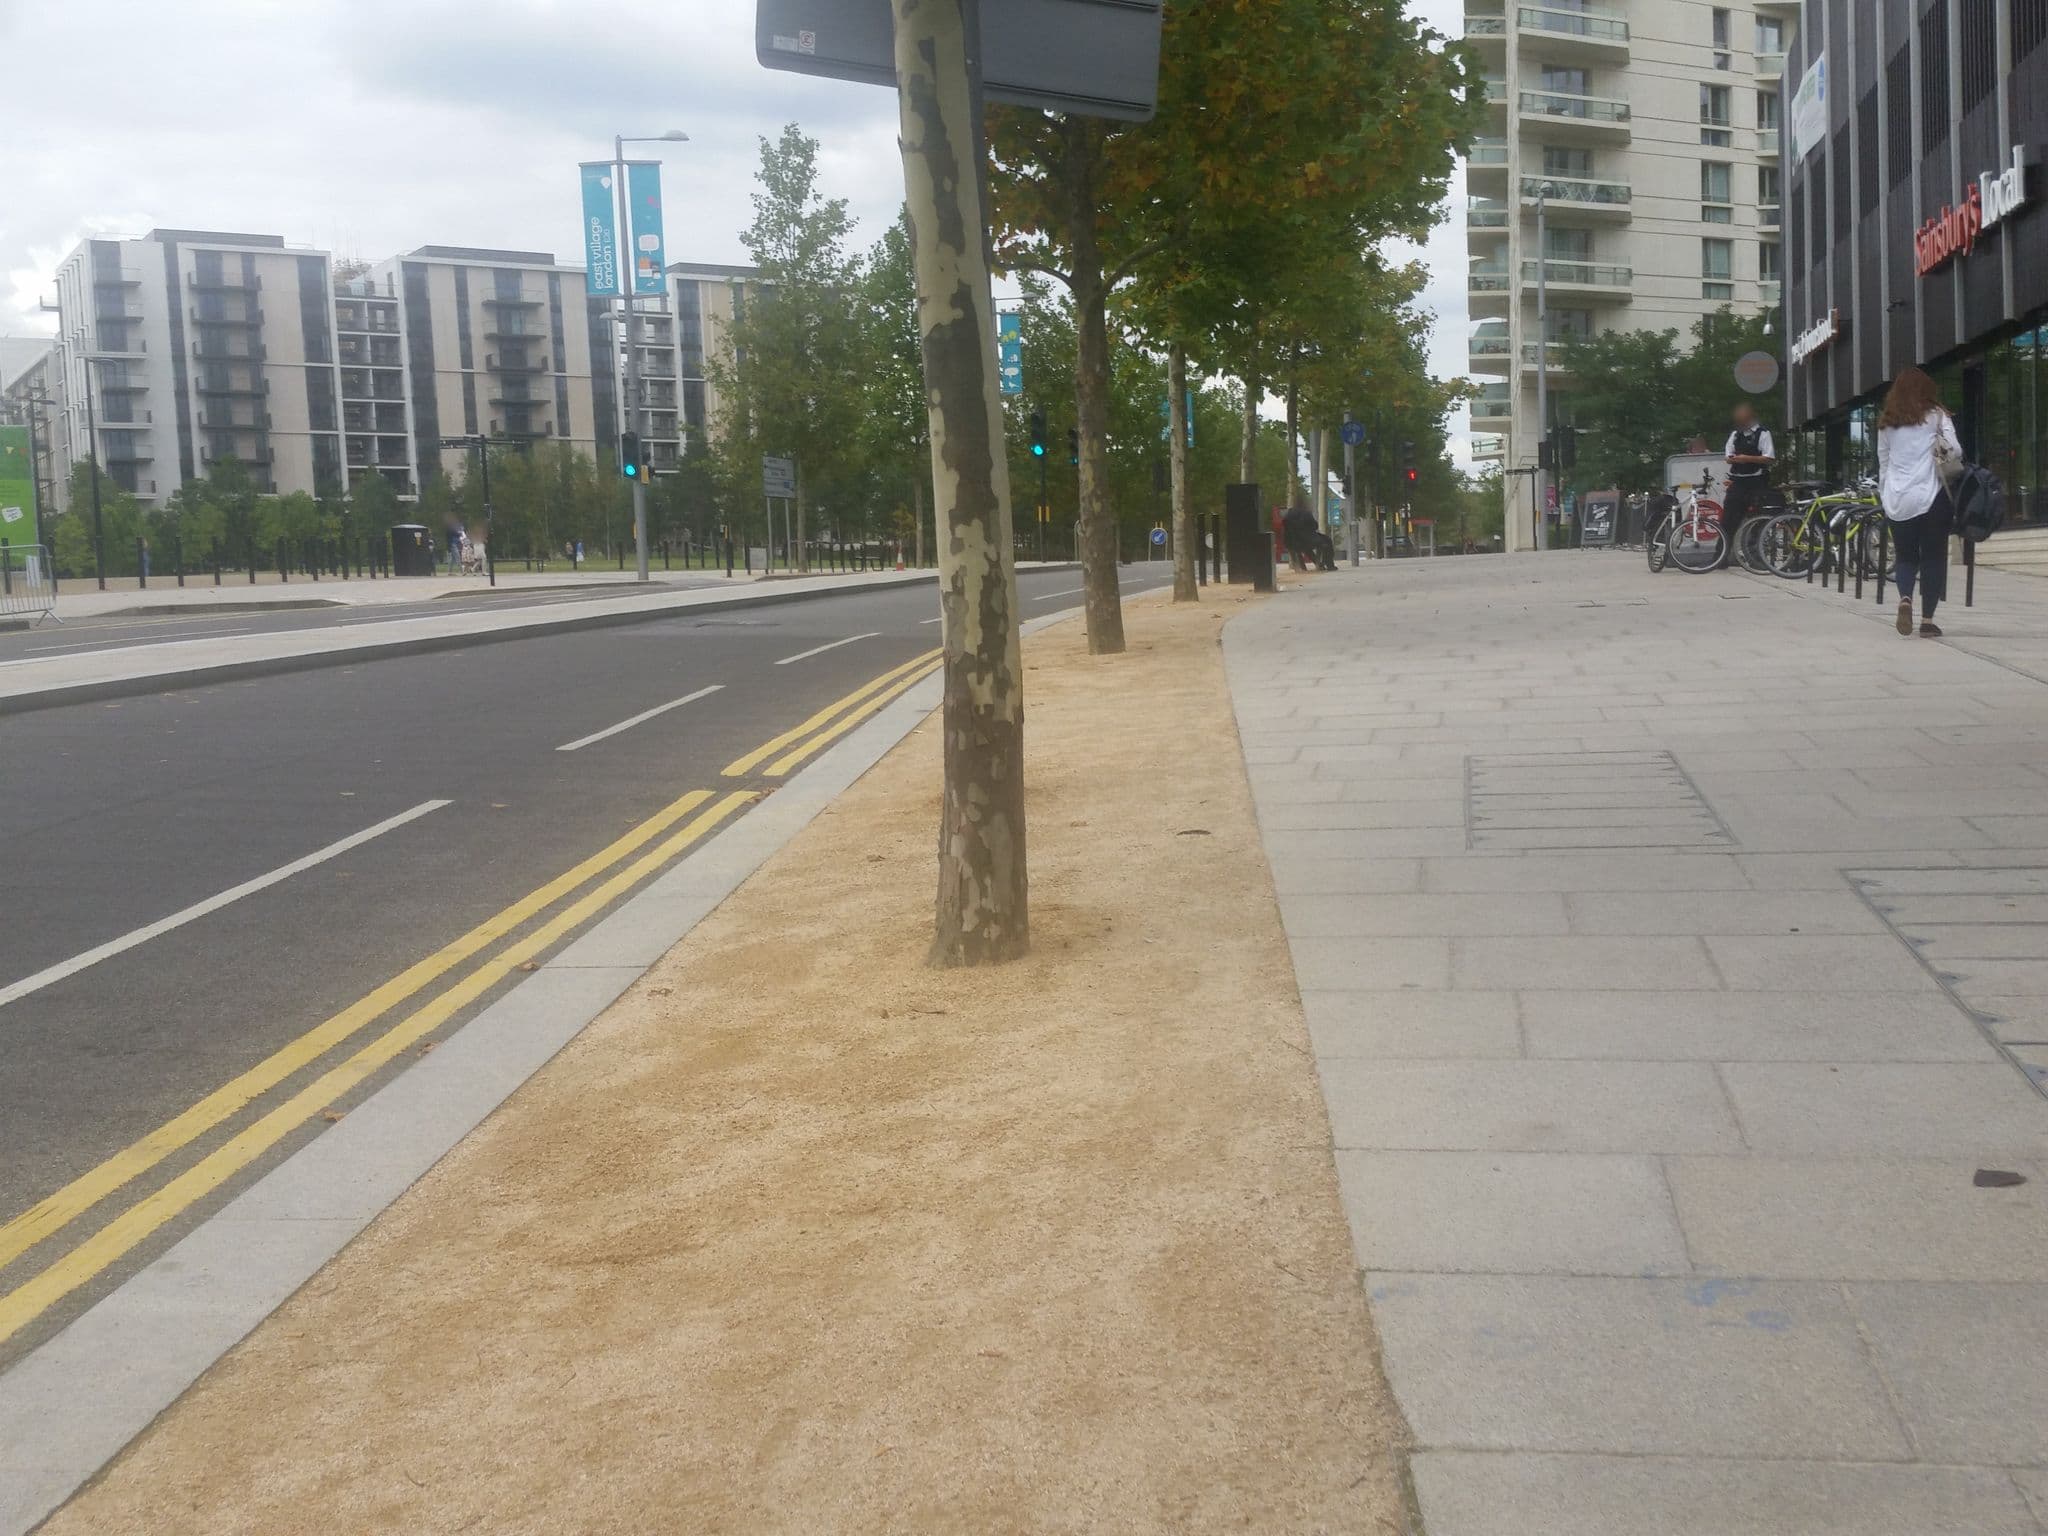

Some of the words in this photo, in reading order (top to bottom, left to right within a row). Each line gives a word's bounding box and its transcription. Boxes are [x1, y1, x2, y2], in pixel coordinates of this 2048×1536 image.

[590, 217, 602, 259] village
[1916, 183, 1982, 277] Sainsbury's
[592, 262, 603, 289] east
[602, 246, 613, 289] london
